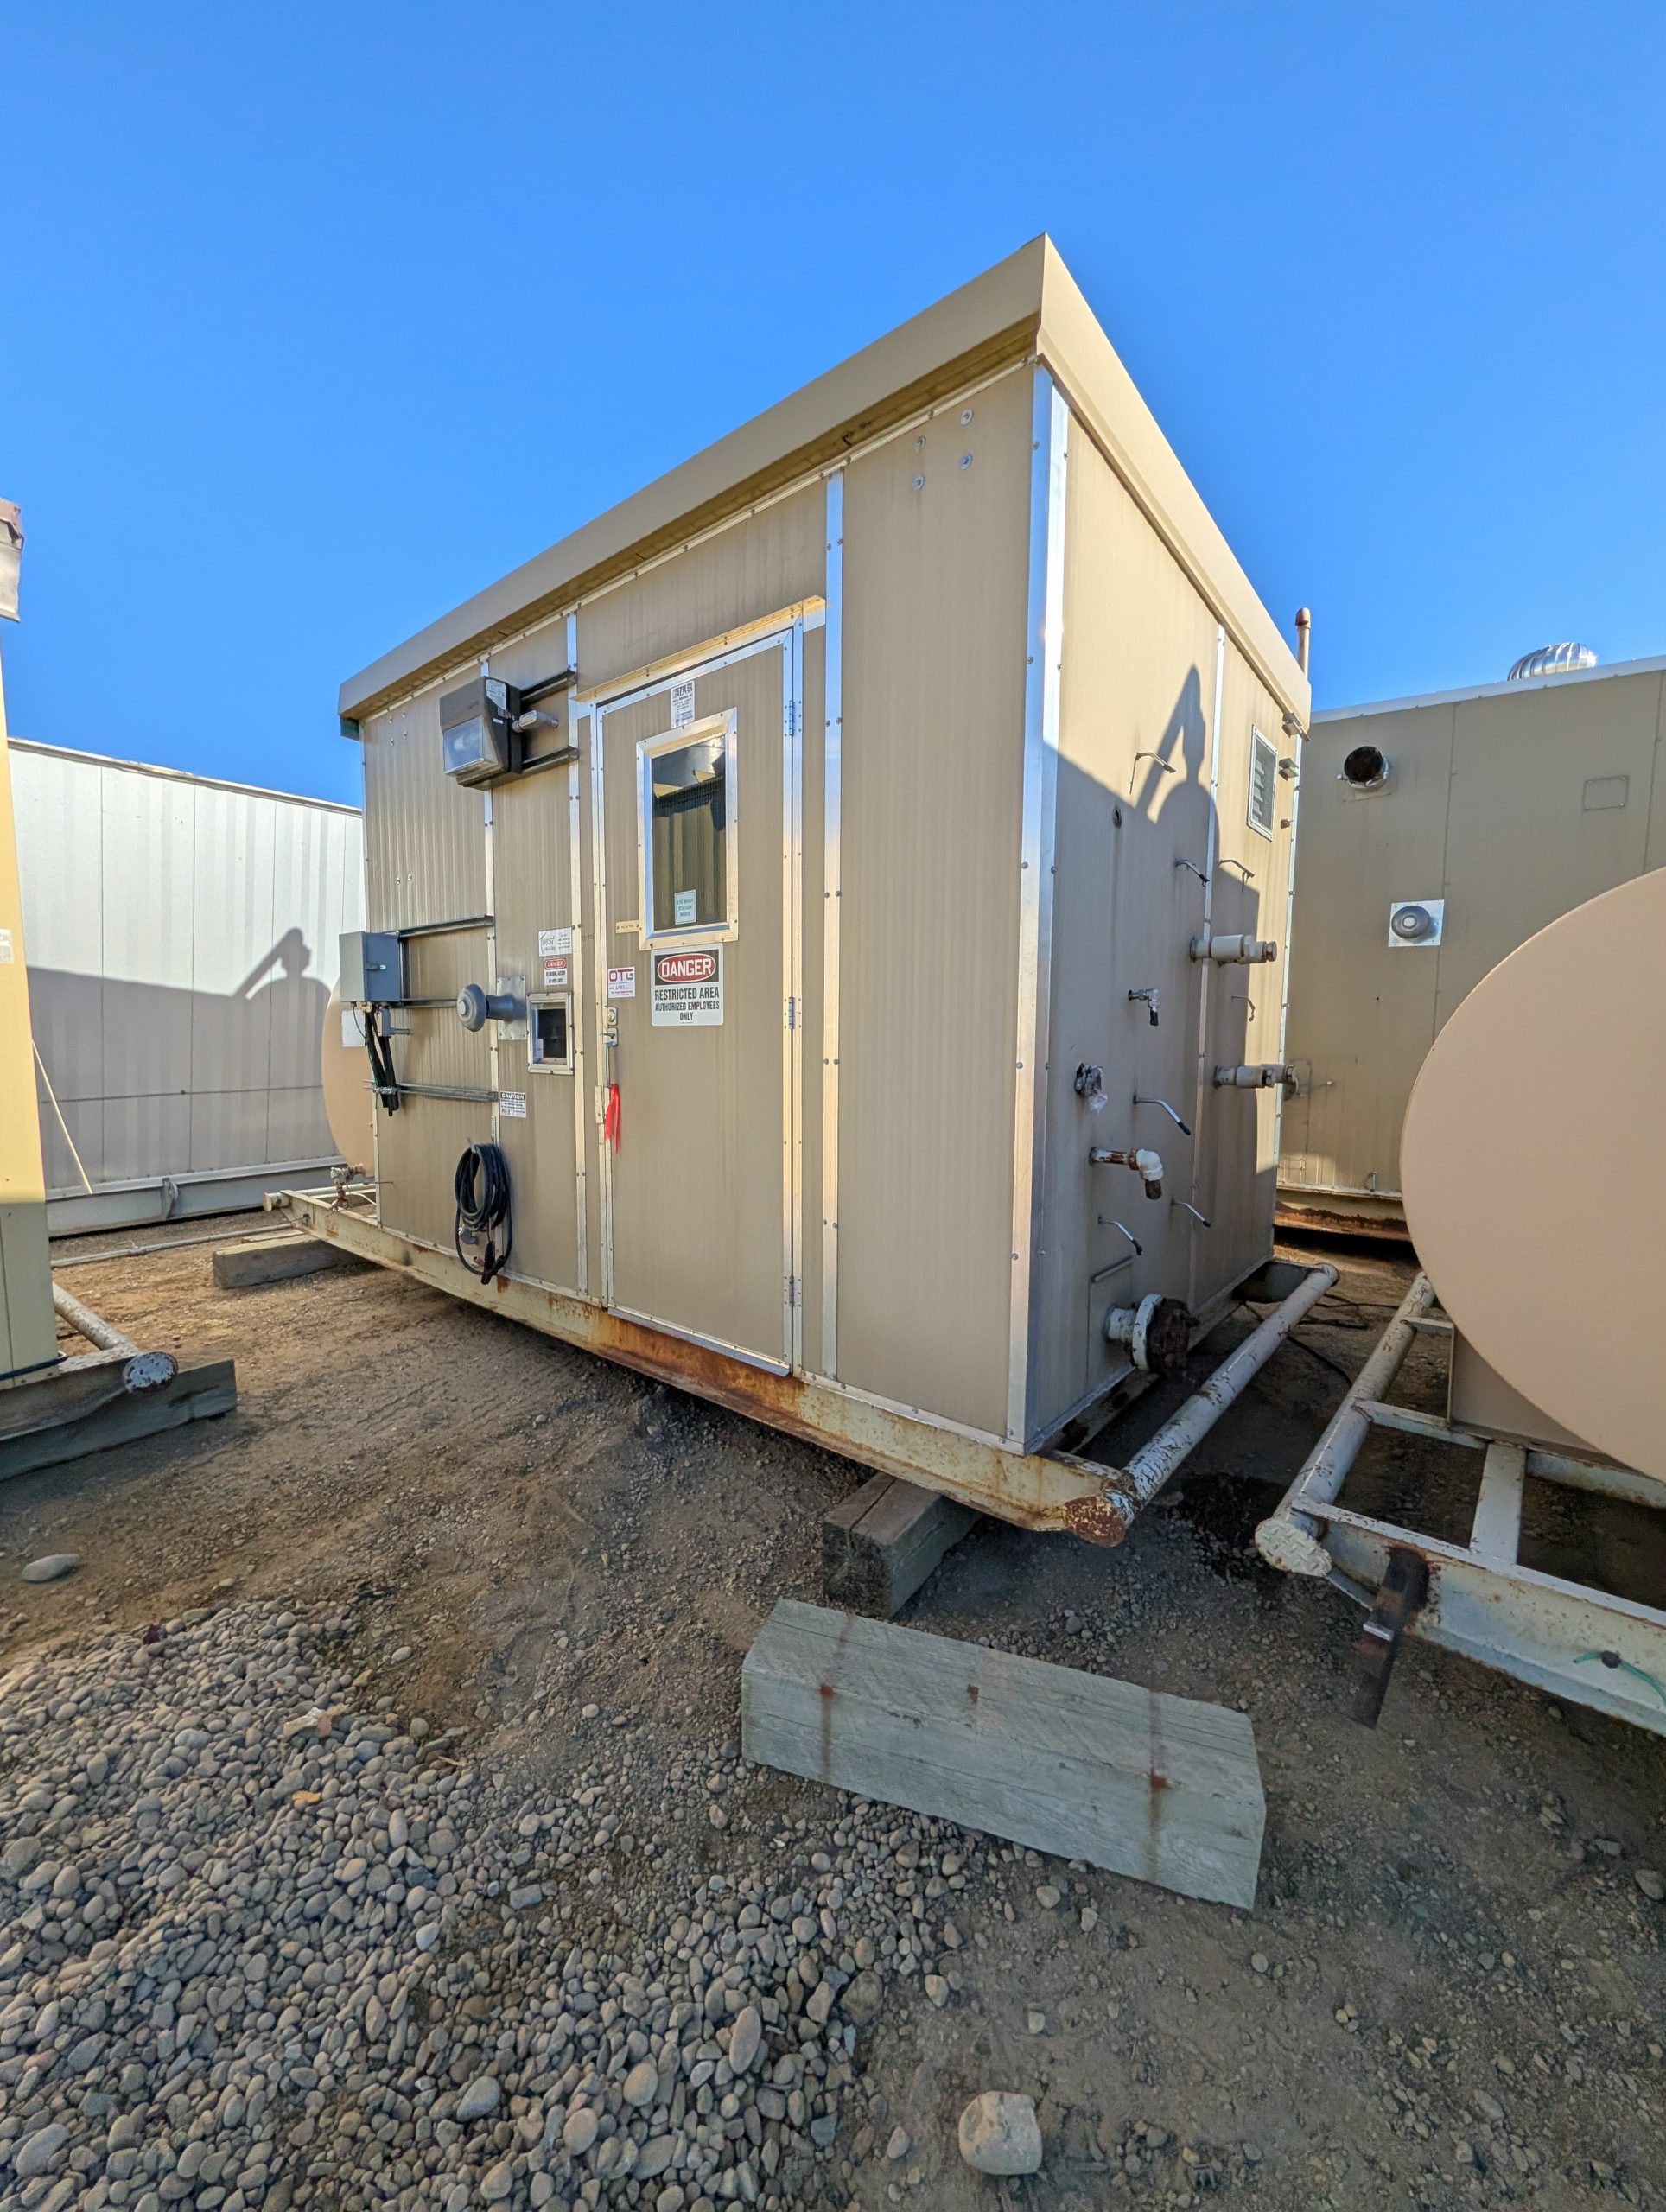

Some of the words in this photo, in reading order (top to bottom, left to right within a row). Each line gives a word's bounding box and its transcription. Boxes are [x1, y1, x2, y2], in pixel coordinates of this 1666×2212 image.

[661, 958, 712, 978] DANGER
[609, 969, 633, 982] OTG
[654, 988, 697, 1001] RESTRICTED
[699, 986, 720, 999] AREA
[655, 1001, 686, 1012] AUTHORIZED
[688, 1001, 720, 1011] EMPLOYEES
[679, 1012, 693, 1020] ONLY
